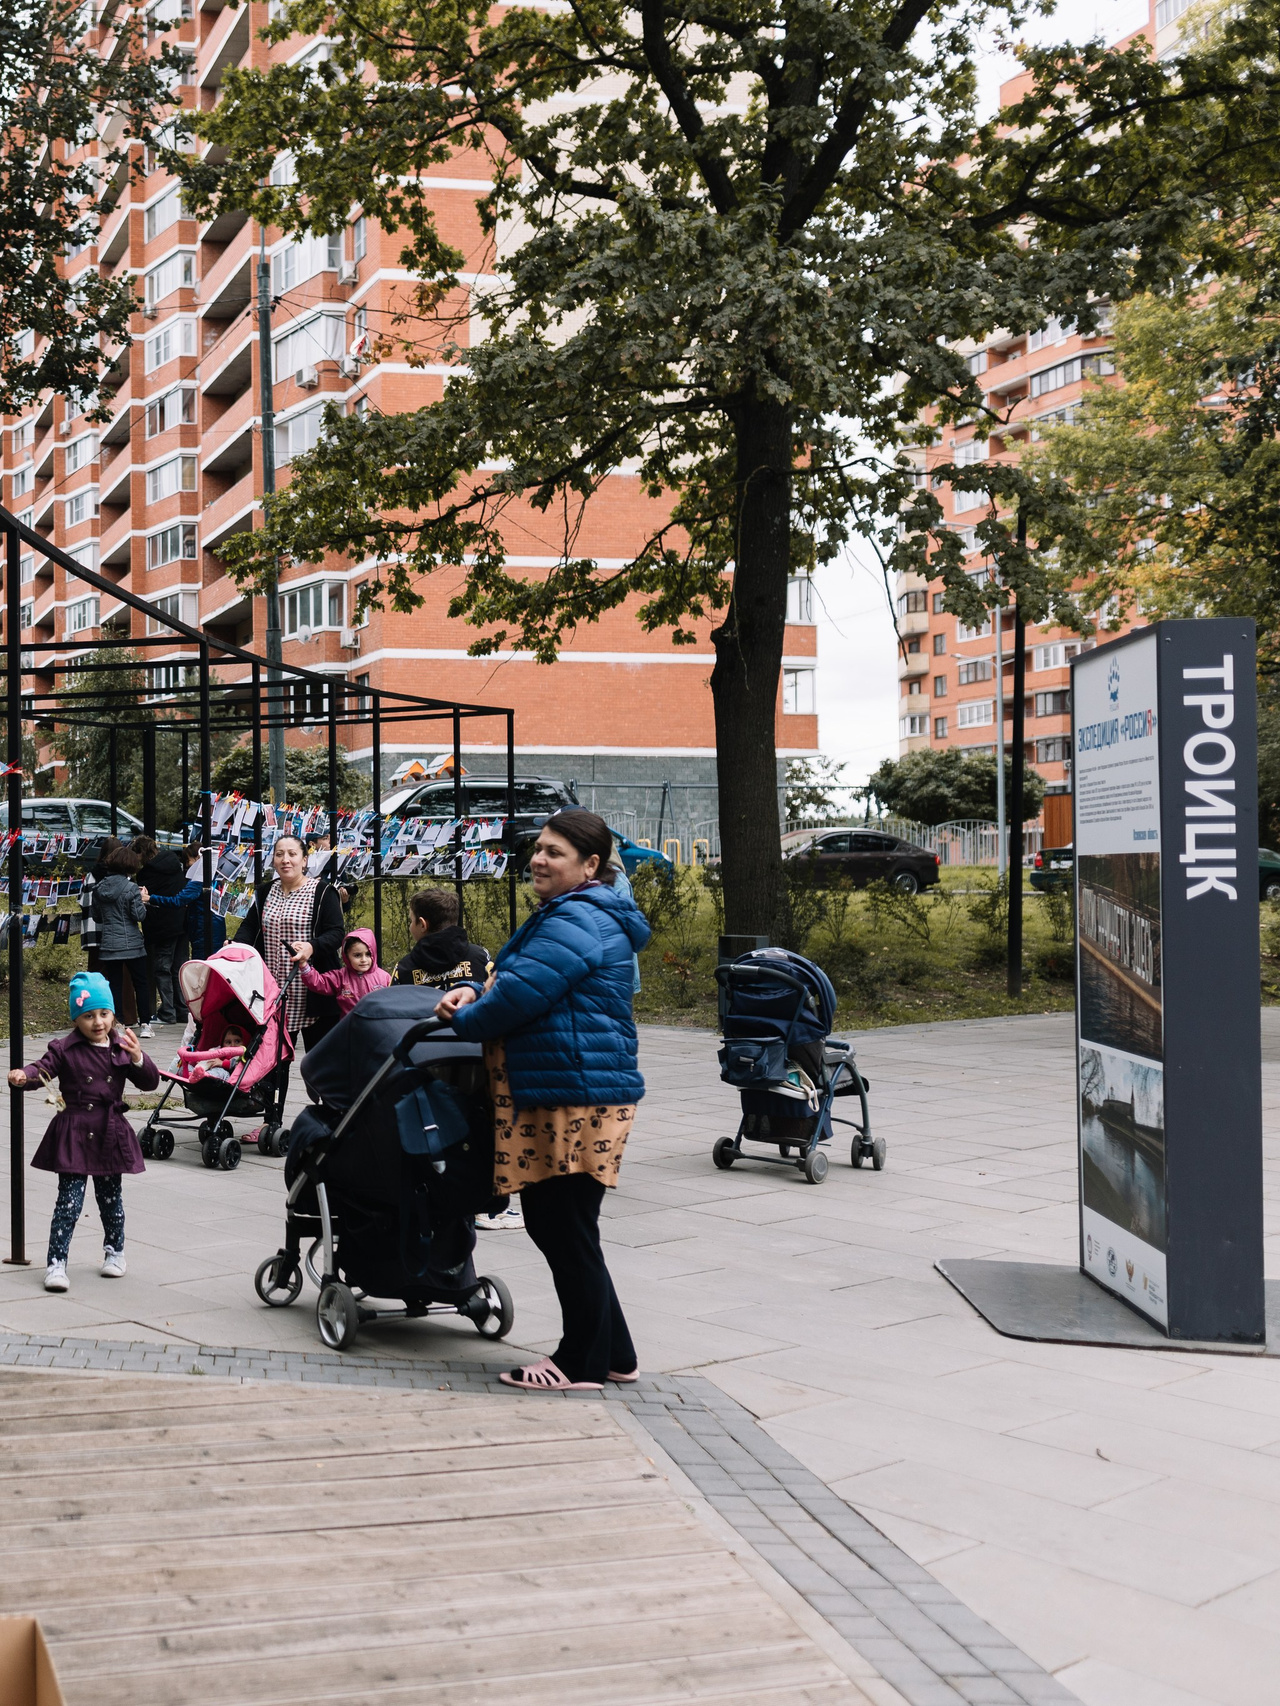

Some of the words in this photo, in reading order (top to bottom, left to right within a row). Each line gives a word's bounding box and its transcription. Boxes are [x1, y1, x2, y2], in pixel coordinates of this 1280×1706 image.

[1079, 718, 1119, 752] ЭКСПЕДИЦИЯ
[1120, 709, 1157, 742] «РОССИЯ»
[1179, 654, 1238, 900] ТРОИЦК
